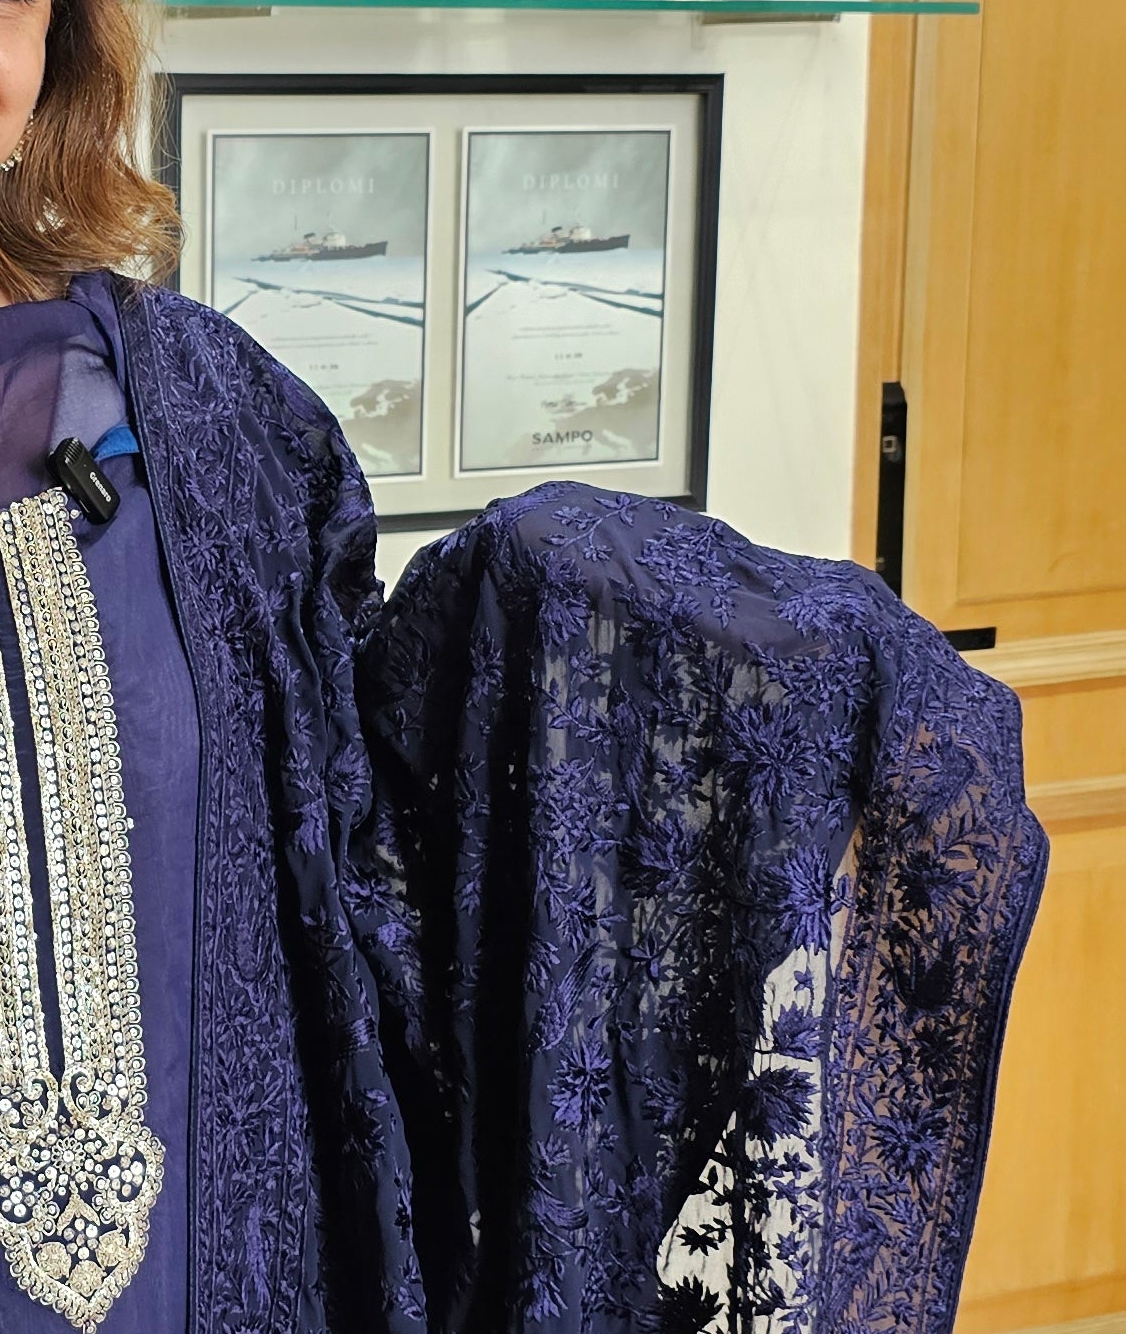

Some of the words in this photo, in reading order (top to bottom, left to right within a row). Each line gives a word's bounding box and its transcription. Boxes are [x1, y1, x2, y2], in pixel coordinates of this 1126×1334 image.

[272, 177, 376, 196] DIPLOMI
[522, 171, 620, 192] DIPLOMI
[531, 430, 594, 446] SAMPO
